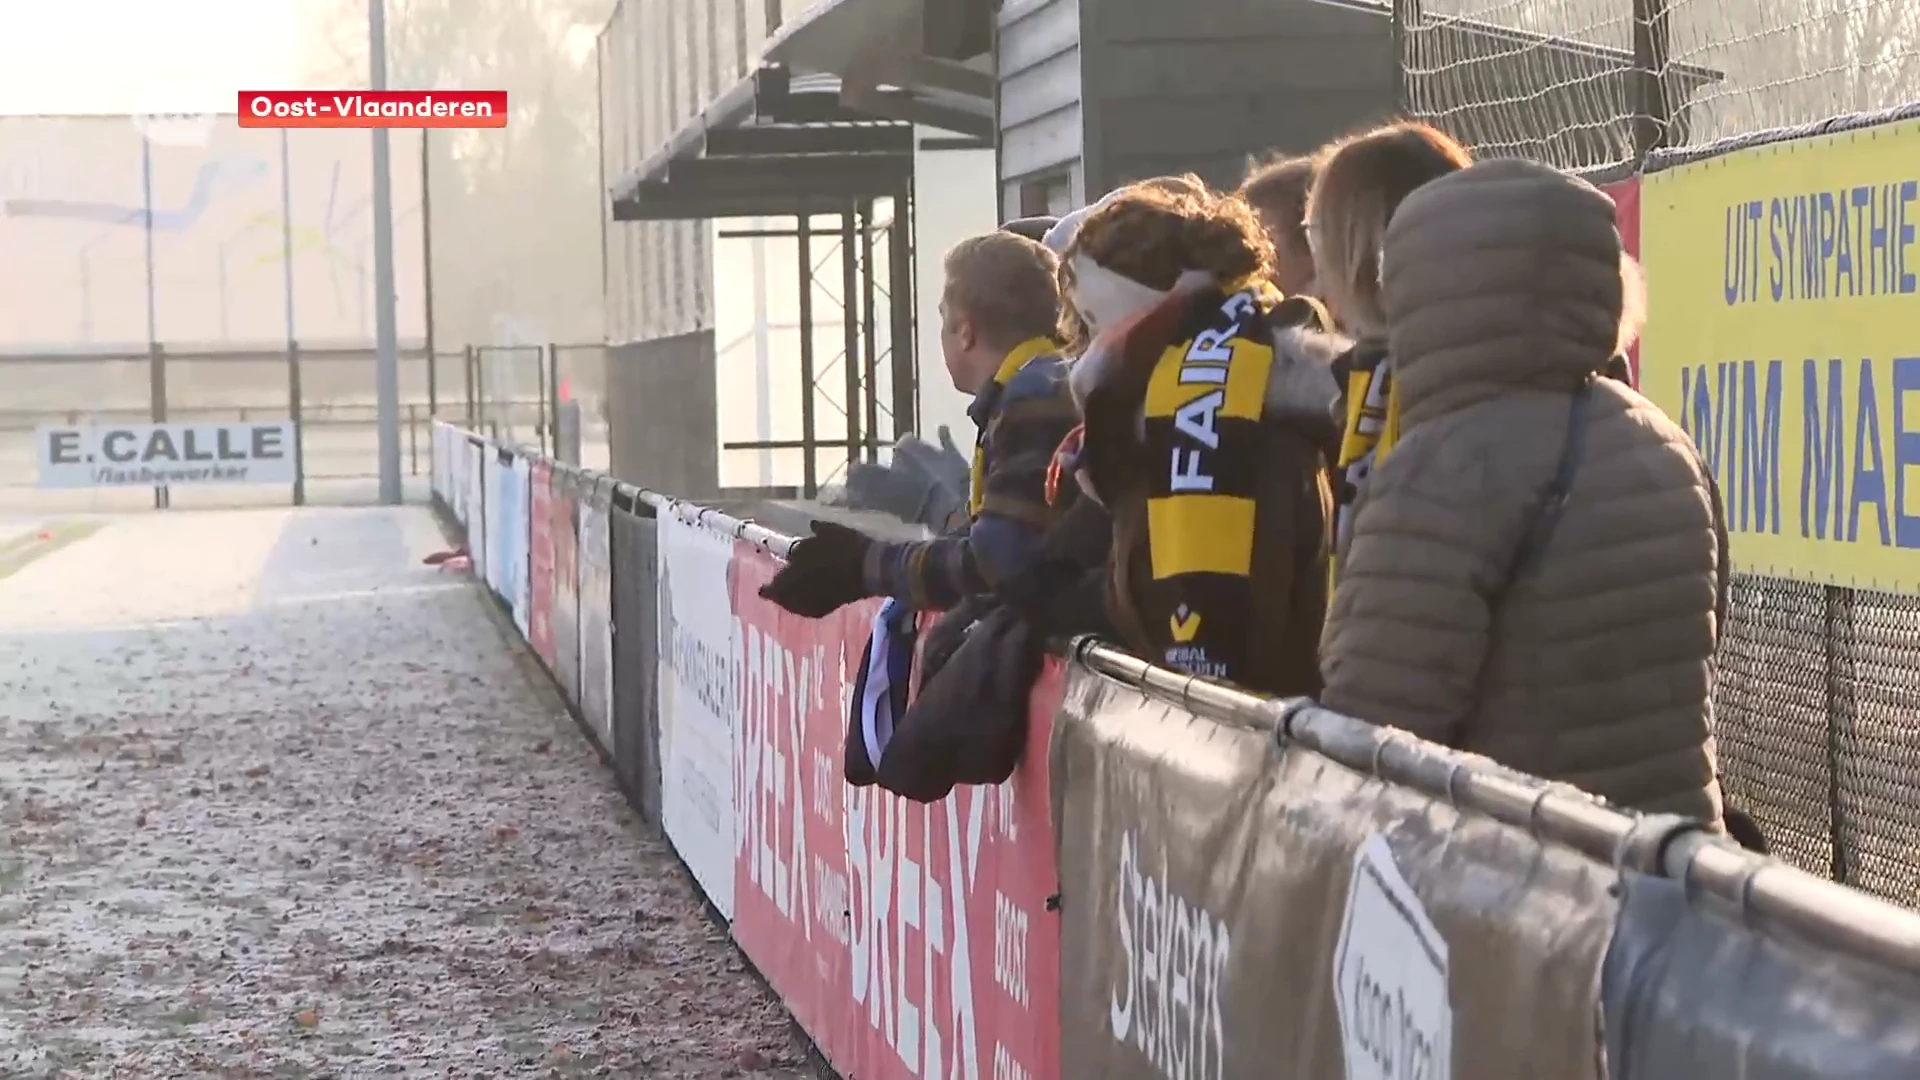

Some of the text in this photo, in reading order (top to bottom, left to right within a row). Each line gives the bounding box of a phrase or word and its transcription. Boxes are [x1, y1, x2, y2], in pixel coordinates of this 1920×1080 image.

[1724, 180, 1918, 306] UIT SYMPATHIE
[49, 426, 284, 464] E.CALLE
[1680, 357, 1920, 550] WIM MAE
